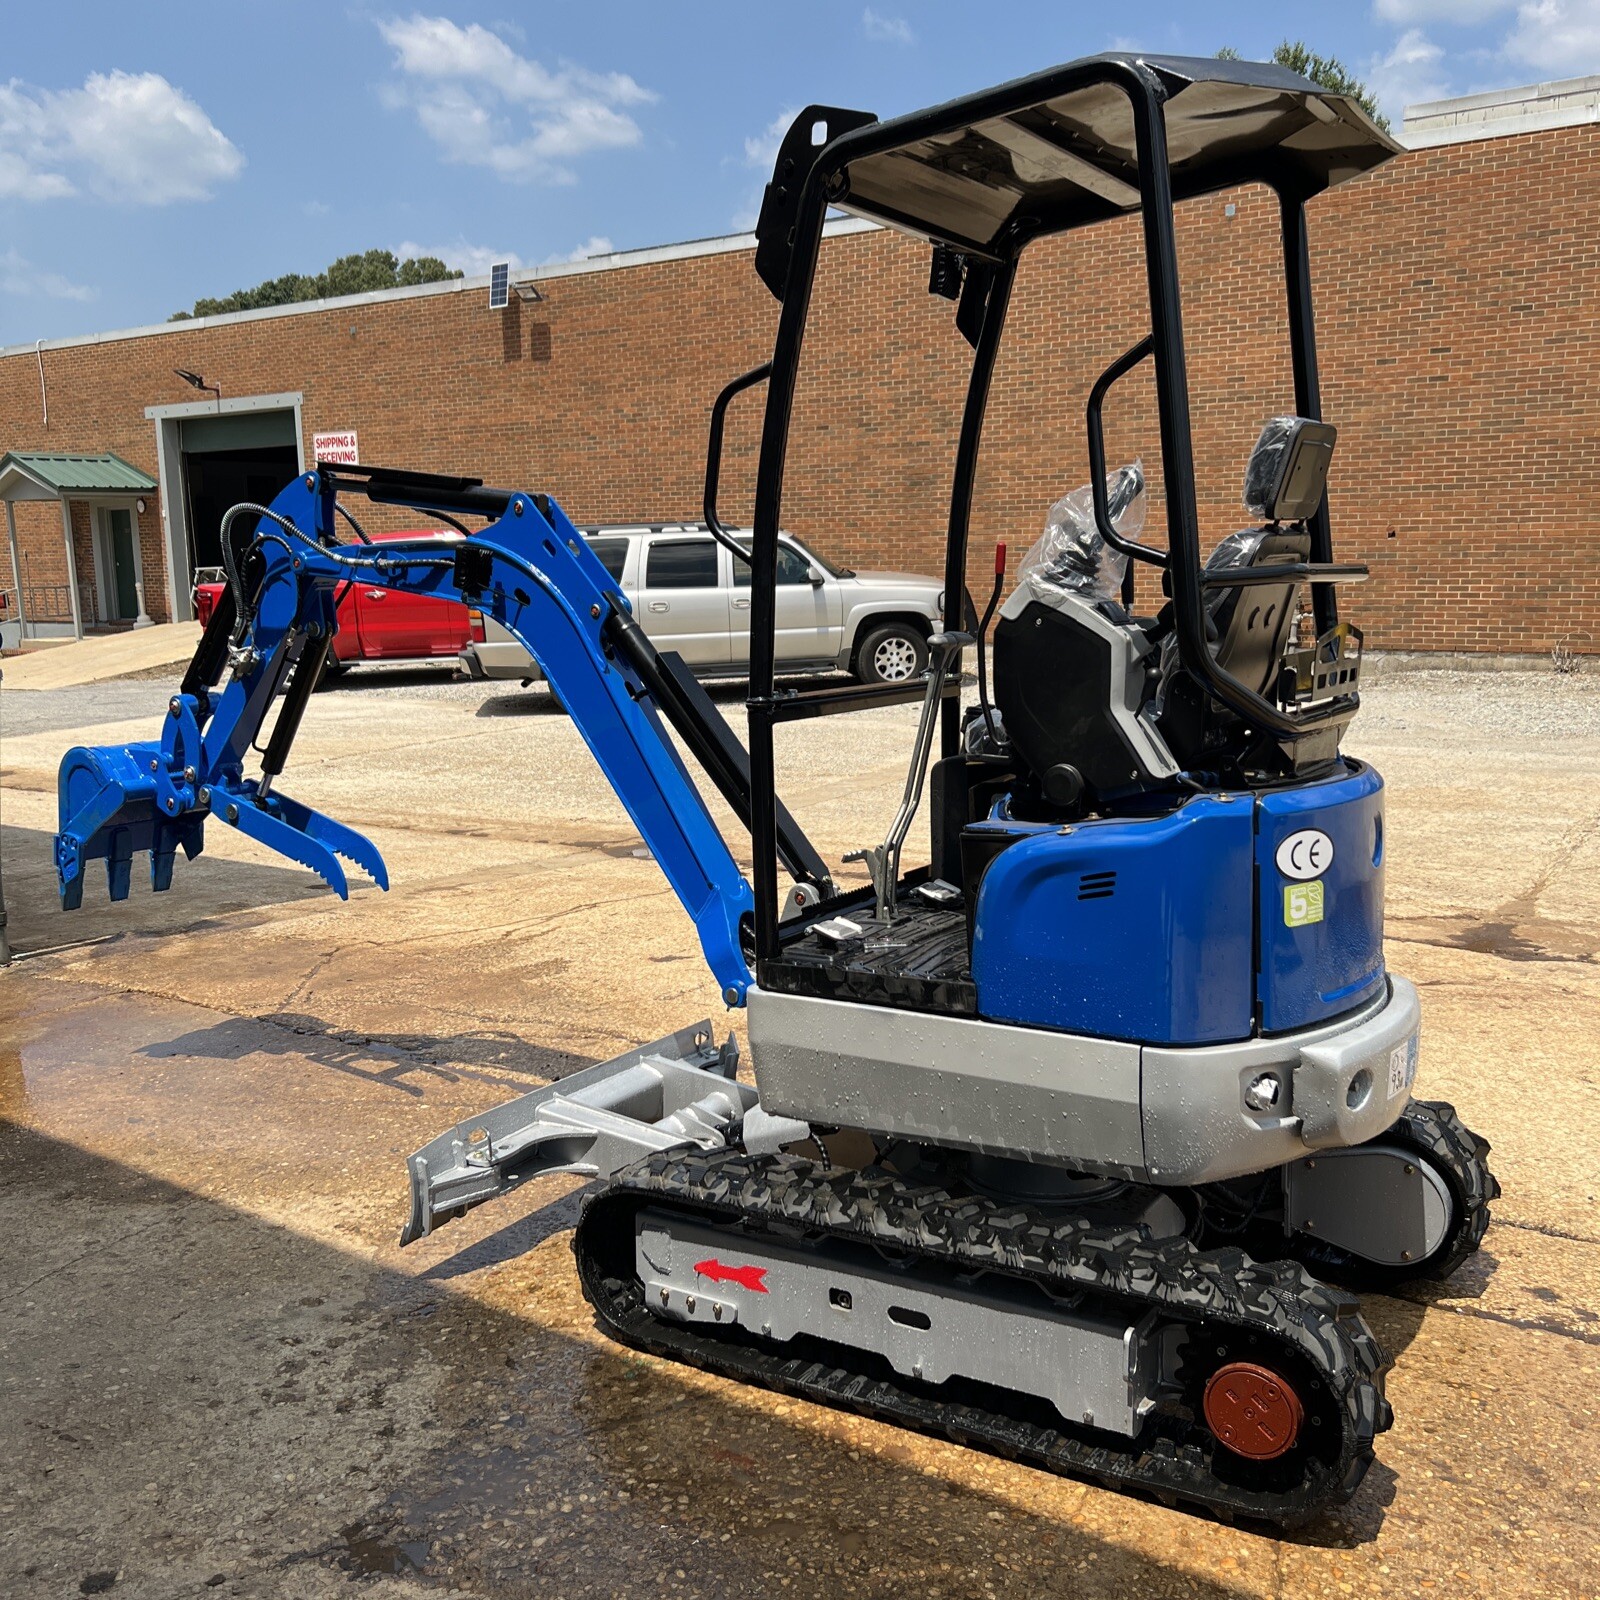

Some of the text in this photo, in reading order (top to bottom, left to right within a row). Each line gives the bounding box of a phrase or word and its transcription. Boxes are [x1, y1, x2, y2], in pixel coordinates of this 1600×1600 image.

[316, 435, 355, 449] SHIPPING &
[1291, 838, 1320, 870] CE
